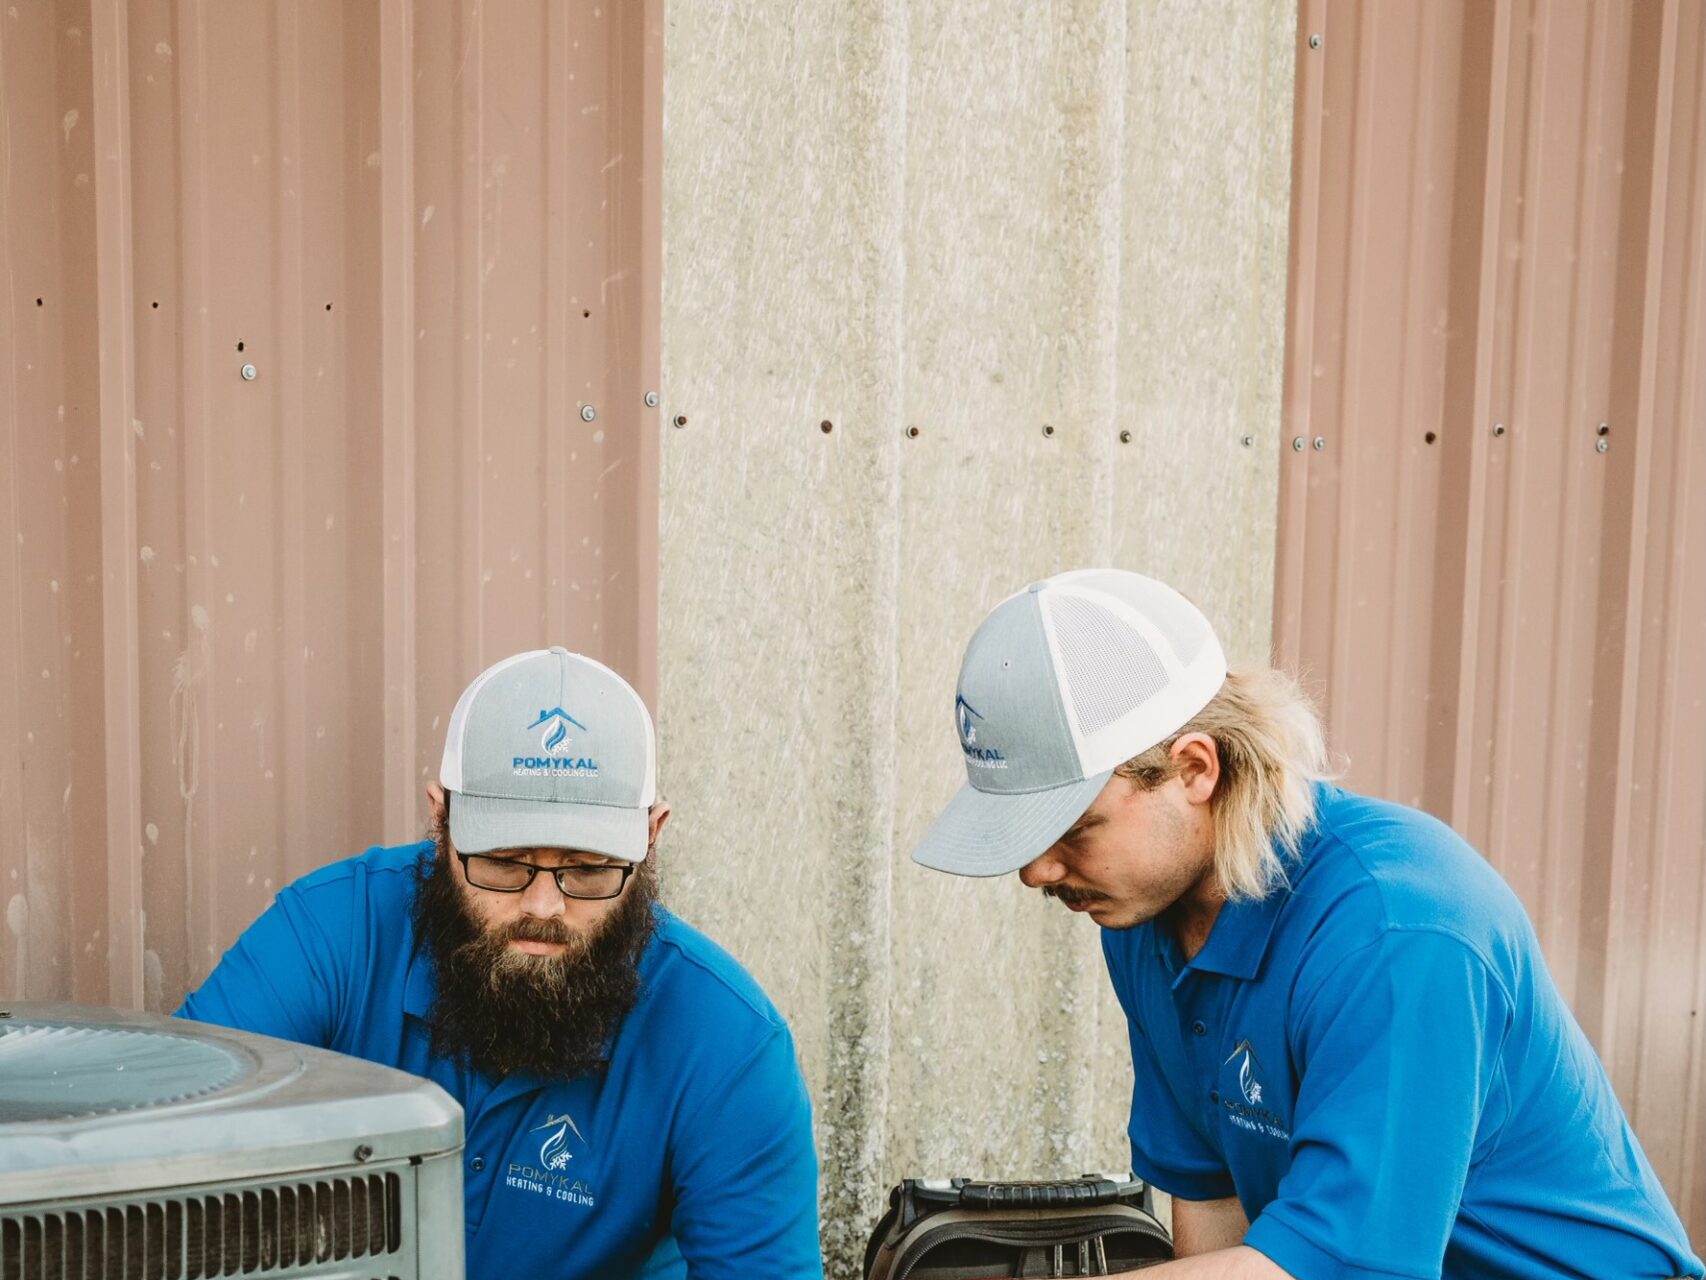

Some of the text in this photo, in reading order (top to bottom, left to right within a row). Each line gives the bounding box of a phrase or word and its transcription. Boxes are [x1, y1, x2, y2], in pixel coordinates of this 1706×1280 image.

[512, 757, 598, 770] POMYKAL
[513, 768, 599, 777] HEATING & COOLING LLC
[508, 1163, 593, 1195] POMYKAL
[506, 1175, 595, 1207] HEATING & COOLING
